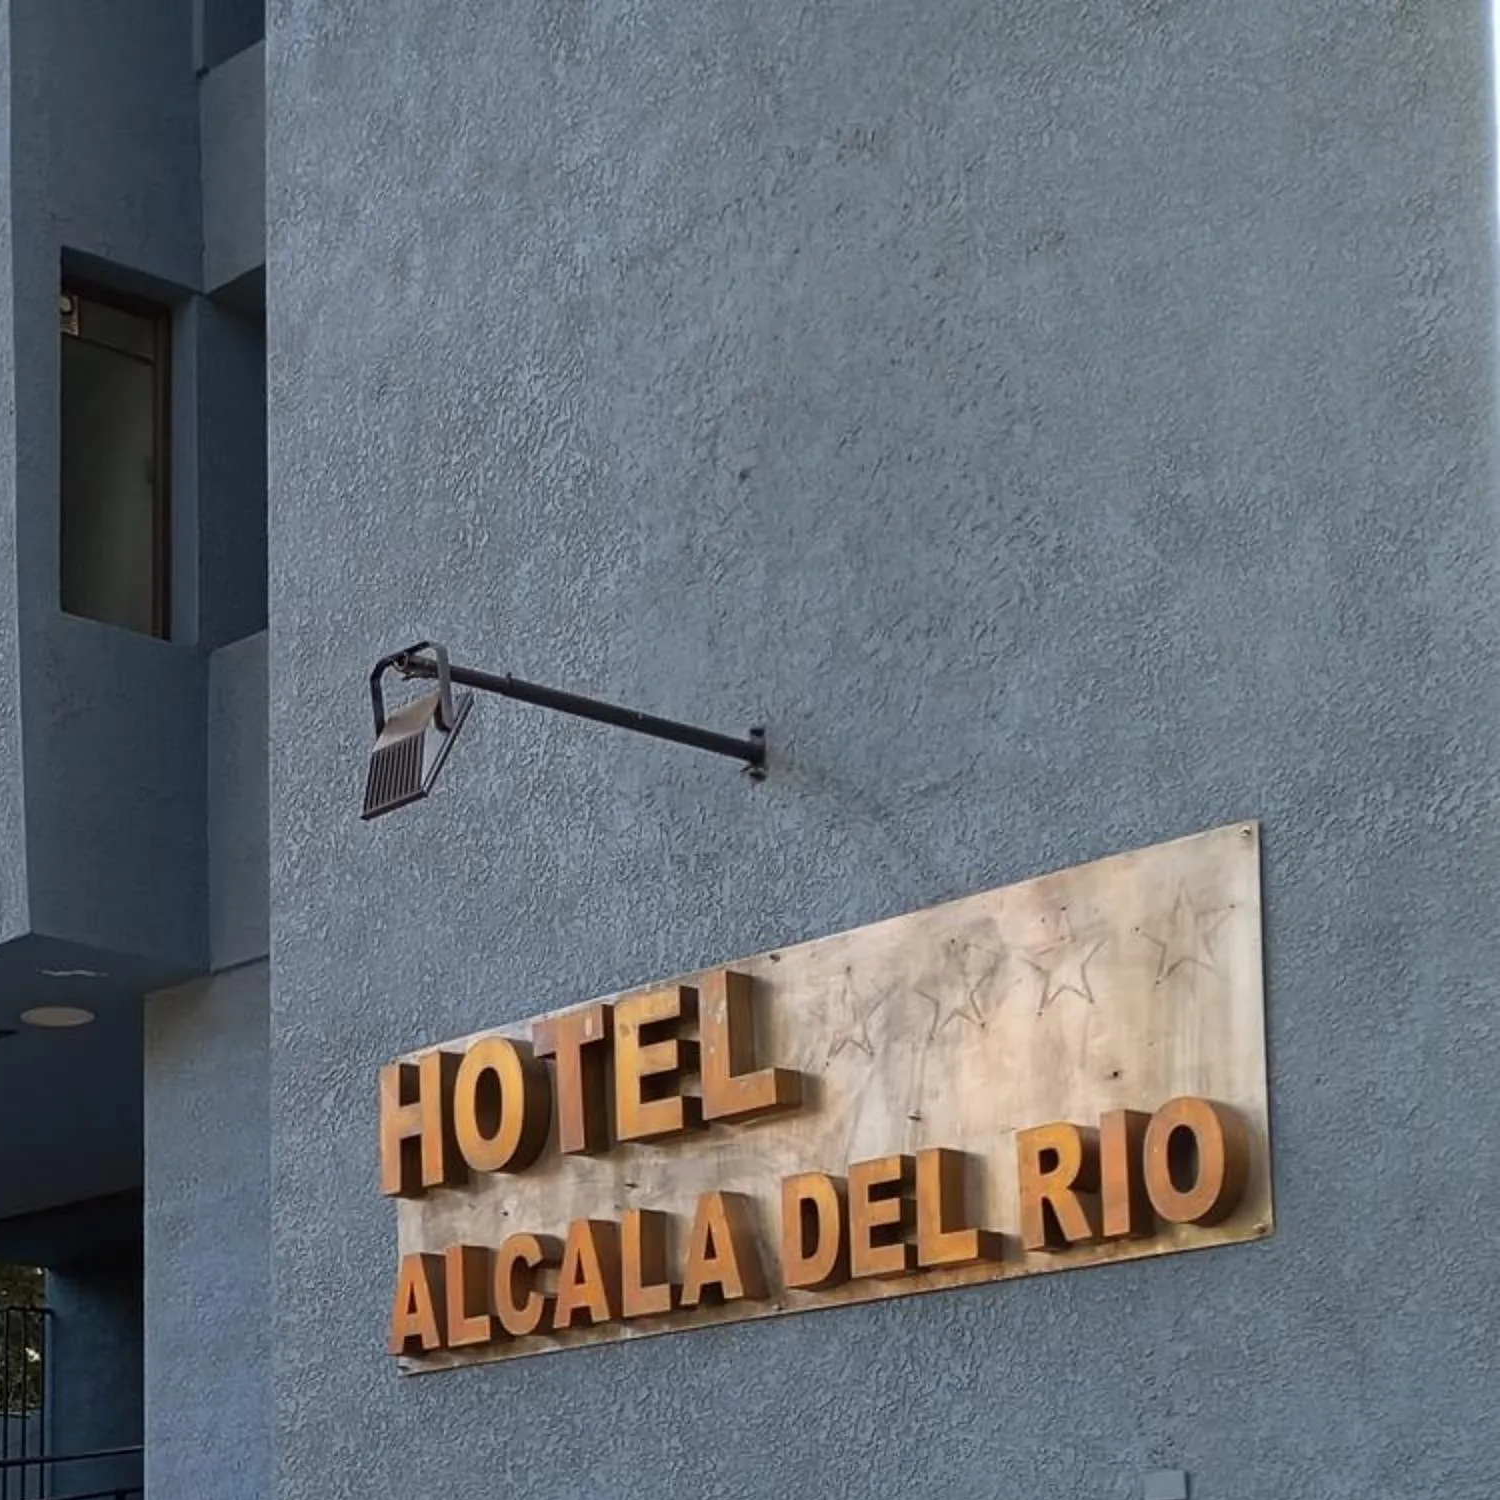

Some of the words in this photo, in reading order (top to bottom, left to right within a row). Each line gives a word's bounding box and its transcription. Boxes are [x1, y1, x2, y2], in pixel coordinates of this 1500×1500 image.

[379, 968, 802, 1197] HOTEL
[388, 1190, 764, 1355] ALCALA
[781, 1146, 1002, 1291] DEL
[1015, 1096, 1250, 1252] RIO
